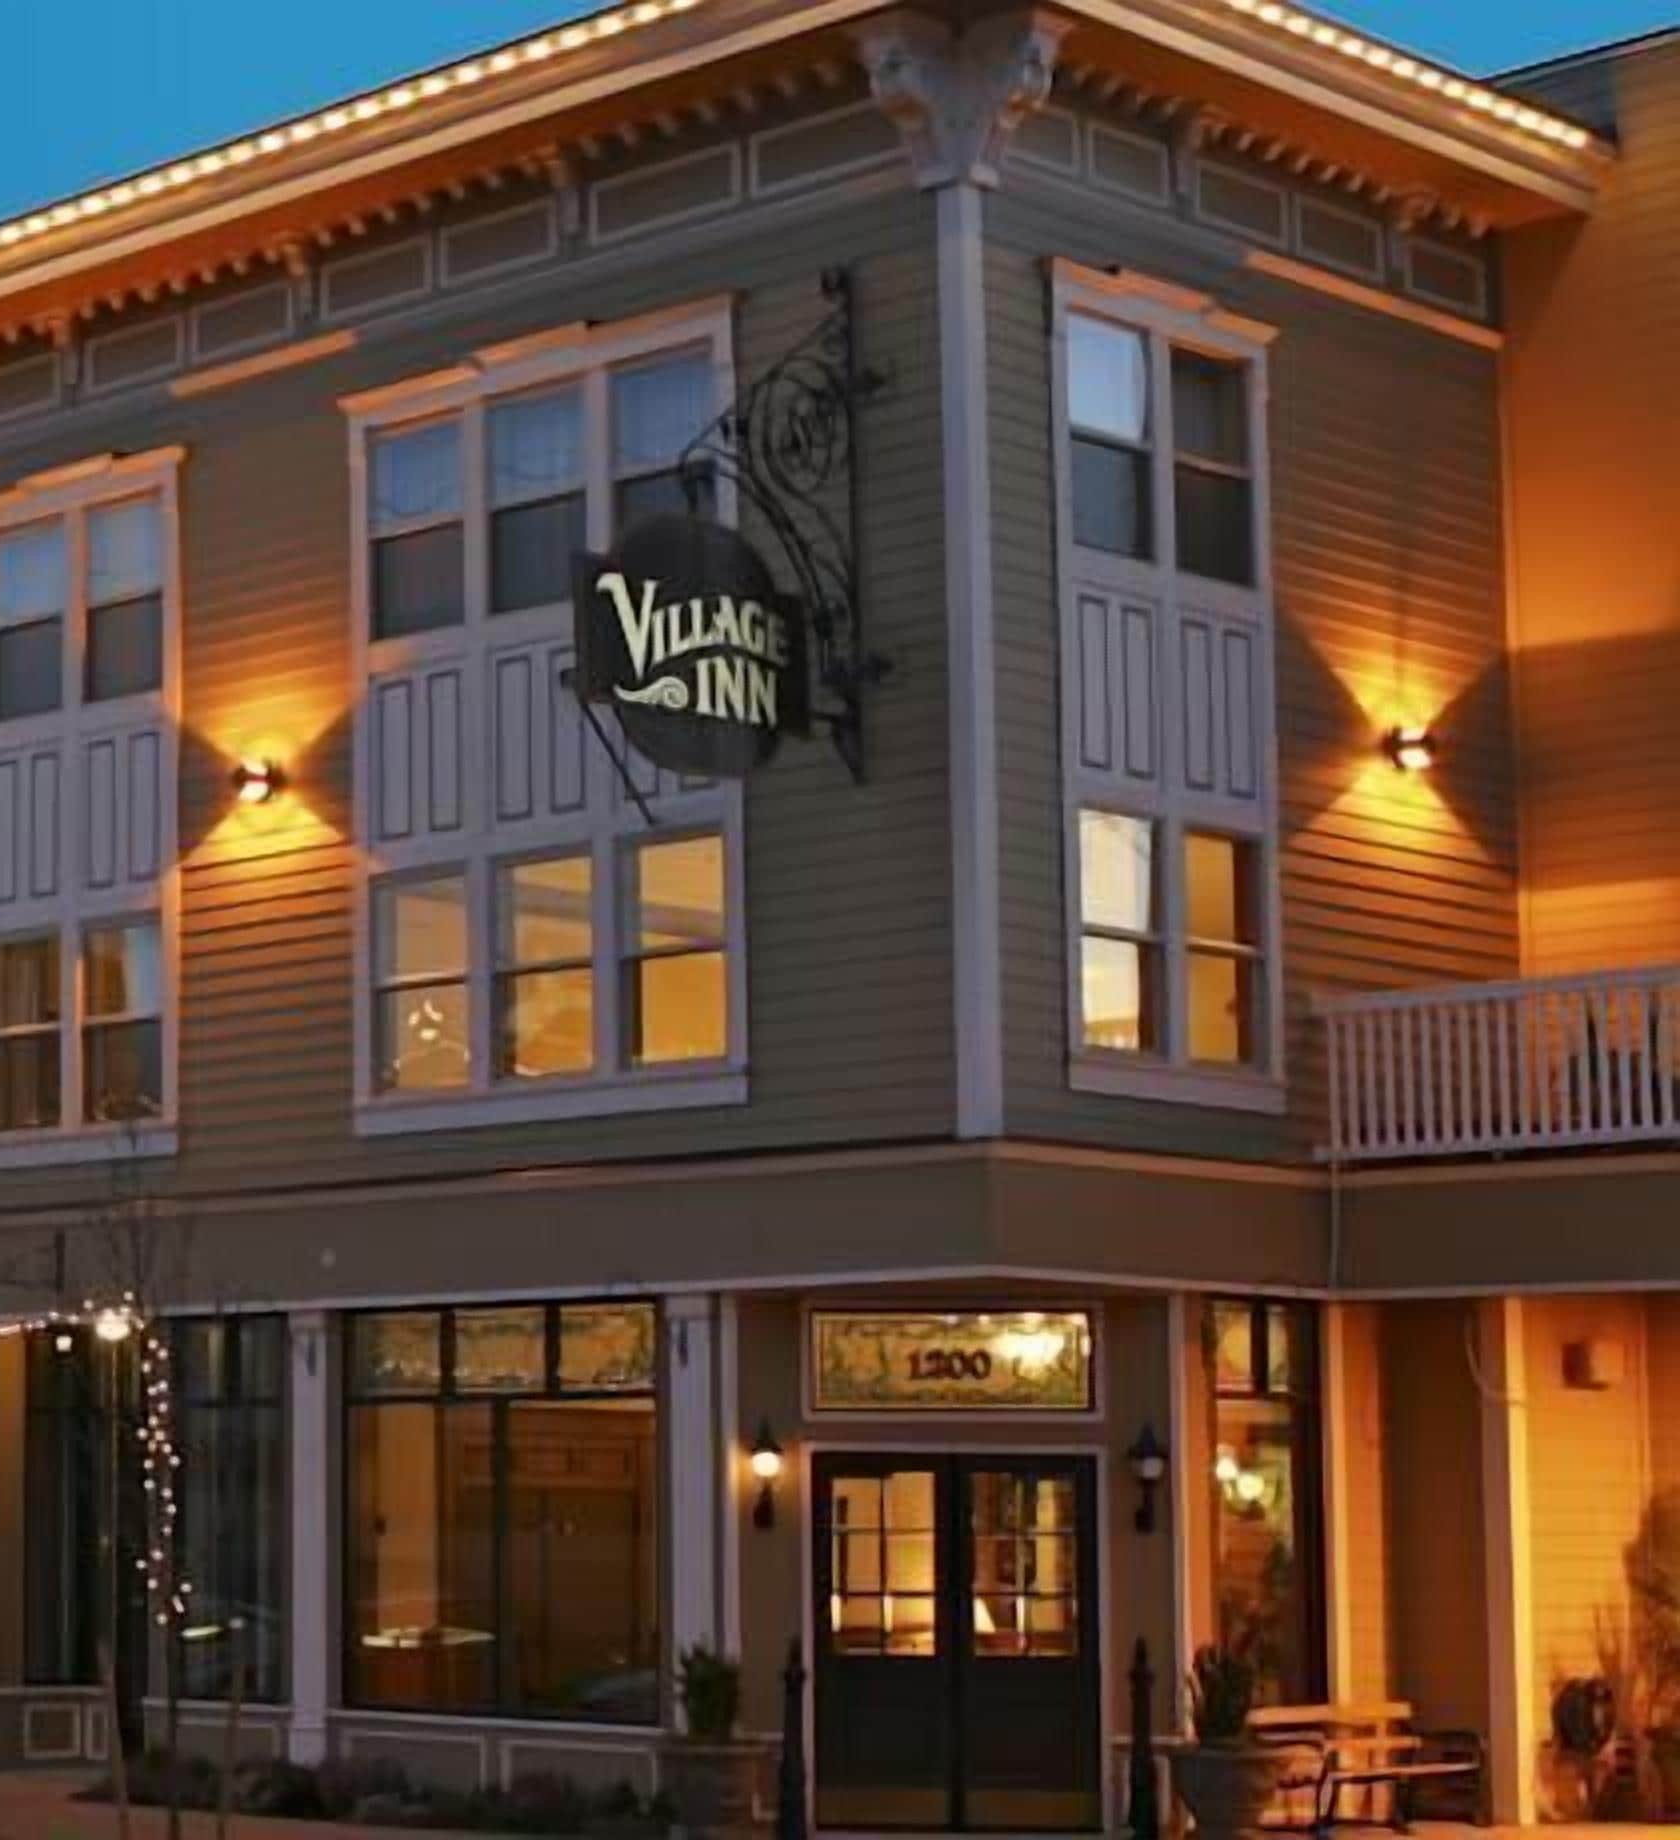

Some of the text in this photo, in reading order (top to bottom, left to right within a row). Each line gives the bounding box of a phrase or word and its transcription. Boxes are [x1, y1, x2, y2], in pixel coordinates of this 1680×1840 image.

[596, 572, 790, 681] VILLAGE
[695, 655, 777, 727] INN
[909, 1349, 992, 1380] 1200
